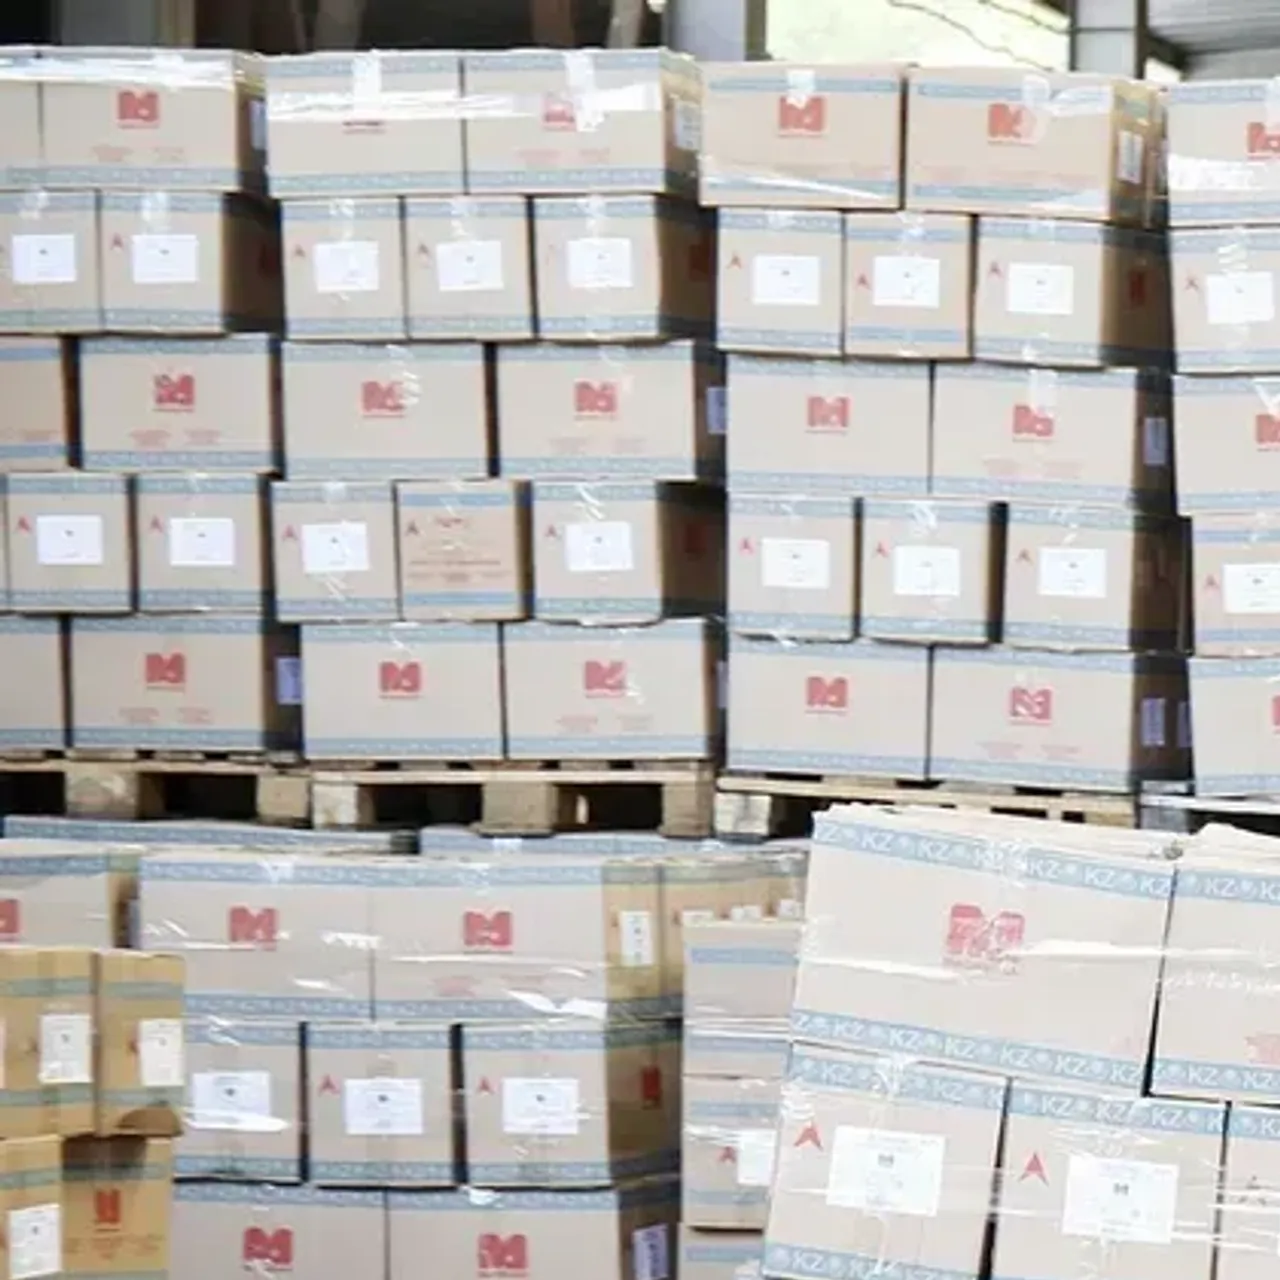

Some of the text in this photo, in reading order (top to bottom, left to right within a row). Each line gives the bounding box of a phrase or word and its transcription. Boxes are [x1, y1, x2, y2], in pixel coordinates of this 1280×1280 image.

[861, 831, 893, 850] KZ
[918, 840, 949, 859] KZ
[1029, 859, 1060, 878] KZ
[1084, 867, 1116, 886] KZ
[1139, 877, 1171, 896] KZ
[1204, 877, 1236, 896] KZ
[833, 1020, 865, 1039] KZ
[889, 1029, 920, 1048] KZ
[944, 1038, 976, 1057] KZ
[999, 1047, 1031, 1066] KZ
[1055, 1056, 1087, 1075] KZ
[821, 1063, 852, 1082] KZ
[932, 1081, 964, 1100] KZ
[1187, 1066, 1219, 1085] KZ
[1243, 1071, 1274, 1090] KZ
[1041, 1096, 1072, 1115] KZ
[1151, 1108, 1183, 1127] KZ
[793, 1252, 824, 1271] KZ
